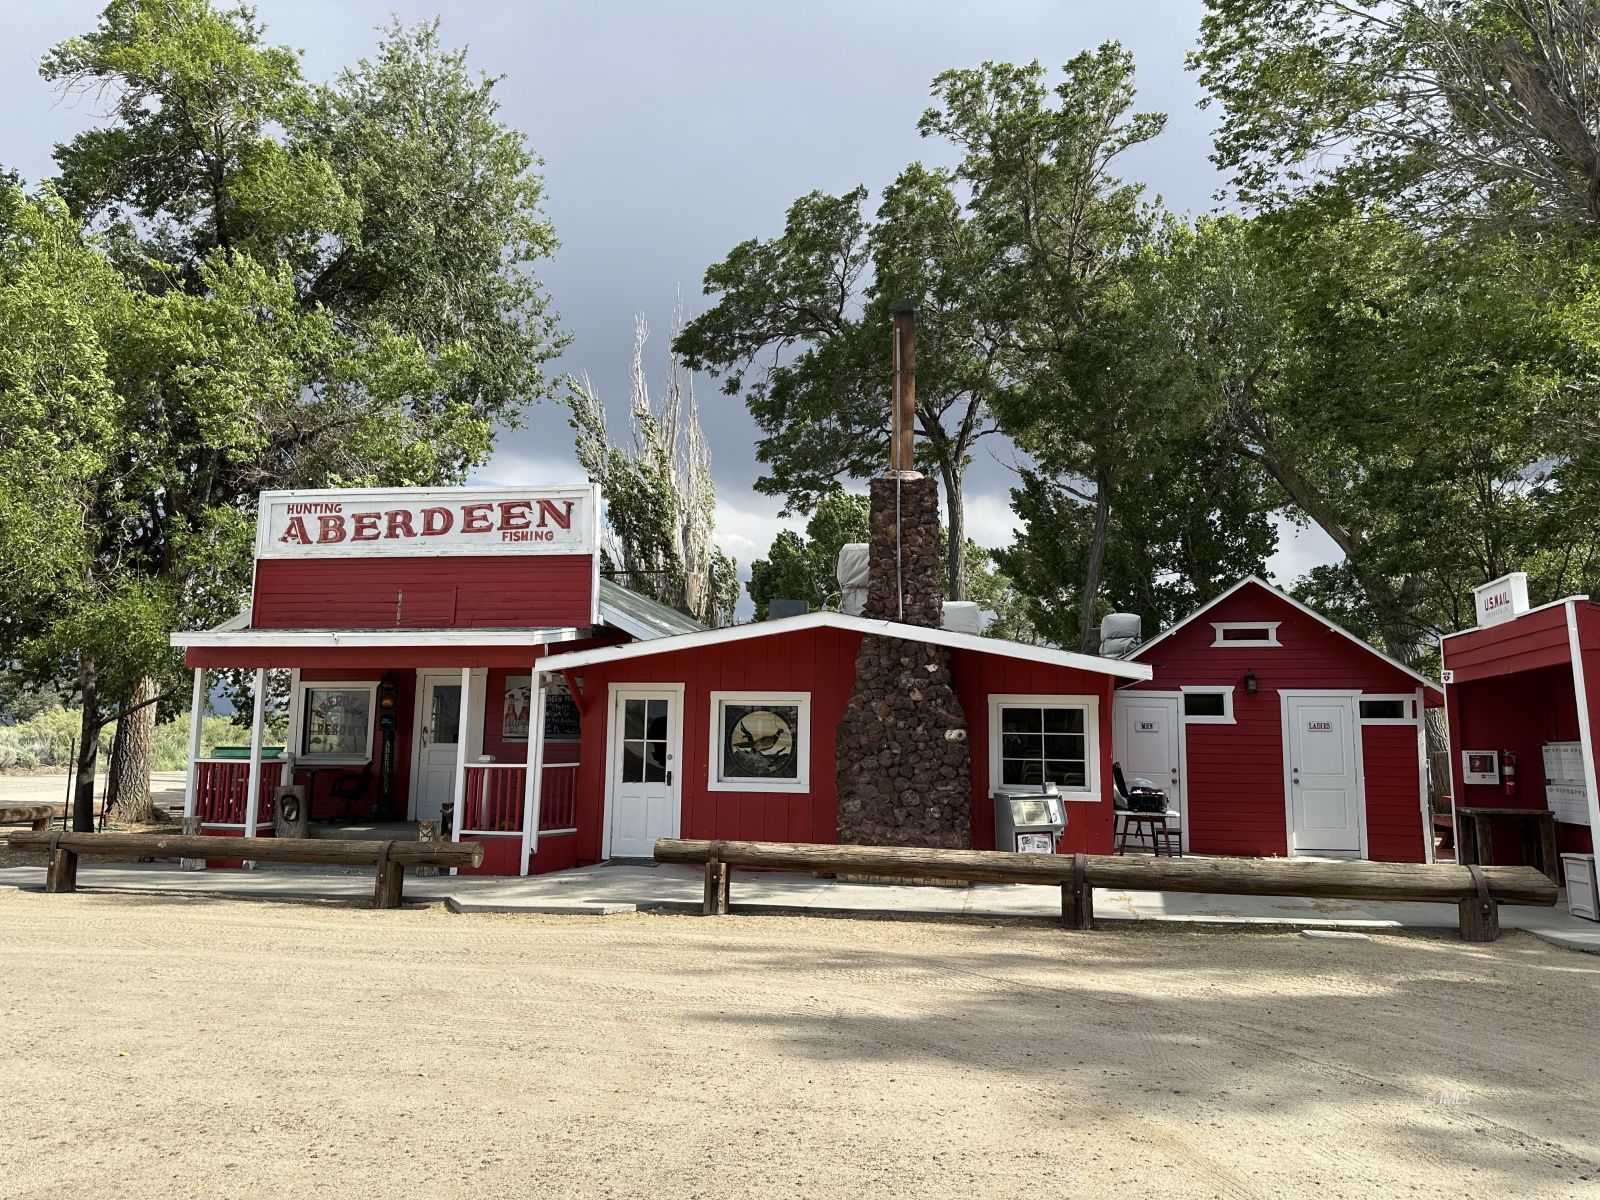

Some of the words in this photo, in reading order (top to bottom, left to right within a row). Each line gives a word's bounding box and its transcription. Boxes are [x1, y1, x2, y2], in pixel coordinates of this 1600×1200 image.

[286, 503, 343, 515] HUNTING
[278, 500, 575, 545] ABERDEEN
[501, 530, 554, 542] FISHING
[1141, 722, 1154, 730] MEN
[1308, 722, 1331, 730] LADIES
